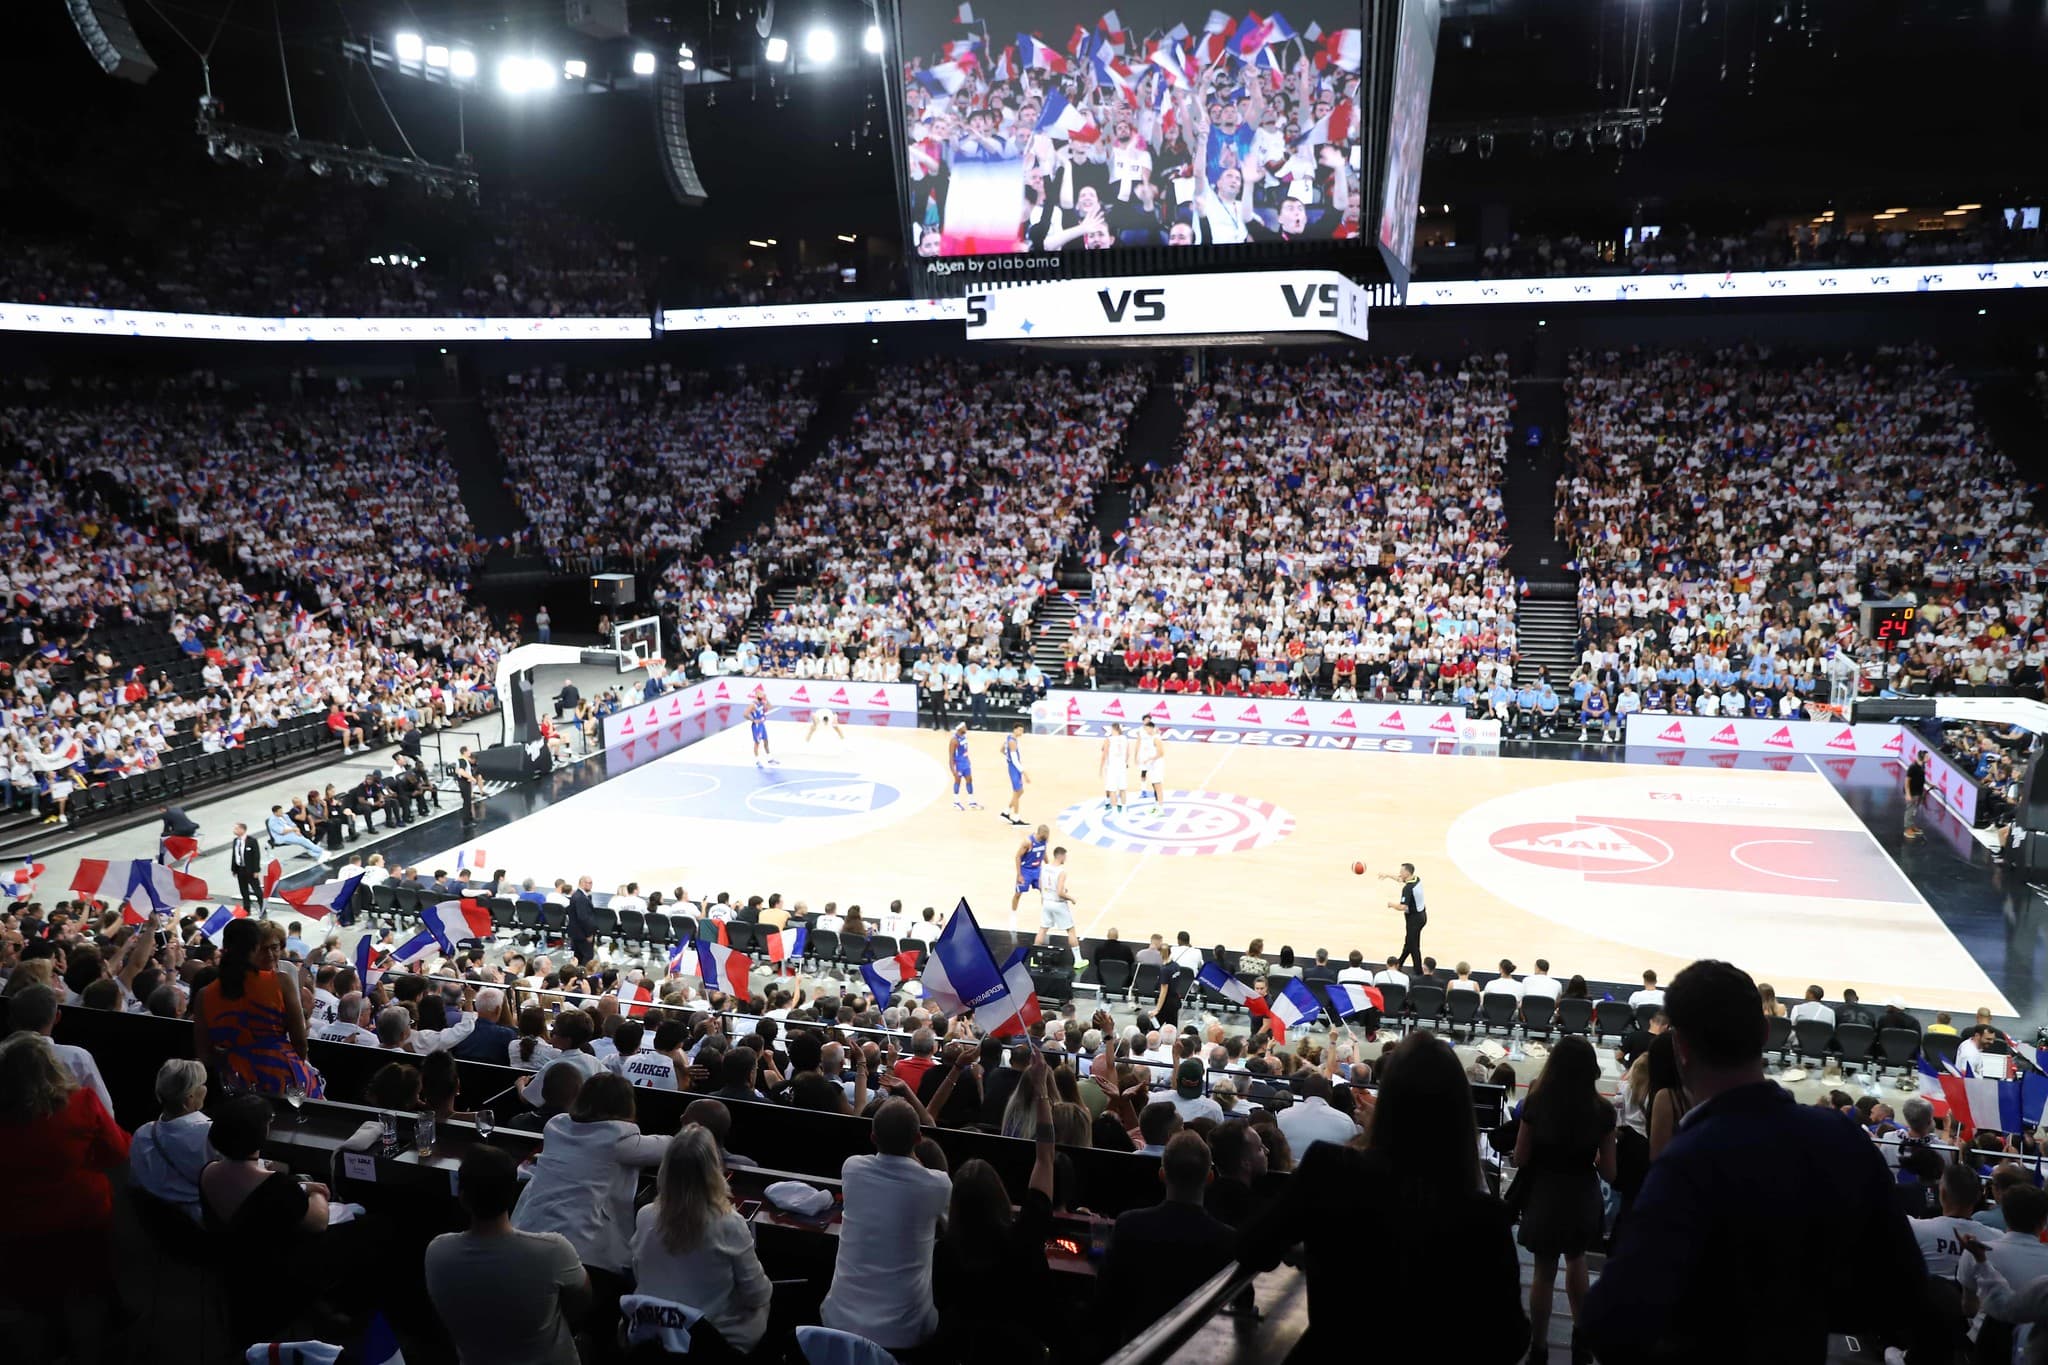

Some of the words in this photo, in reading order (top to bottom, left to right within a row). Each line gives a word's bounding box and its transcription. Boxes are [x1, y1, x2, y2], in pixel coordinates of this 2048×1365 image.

[968, 258, 984, 272] by
[987, 257, 1060, 270] alabama
[1096, 288, 1165, 323] VS
[1279, 283, 1339, 318] VS
[1904, 607, 1914, 620] 0
[1879, 620, 1908, 637] 24
[1527, 838, 1633, 851] MAIF
[627, 1062, 671, 1078] PARKER
